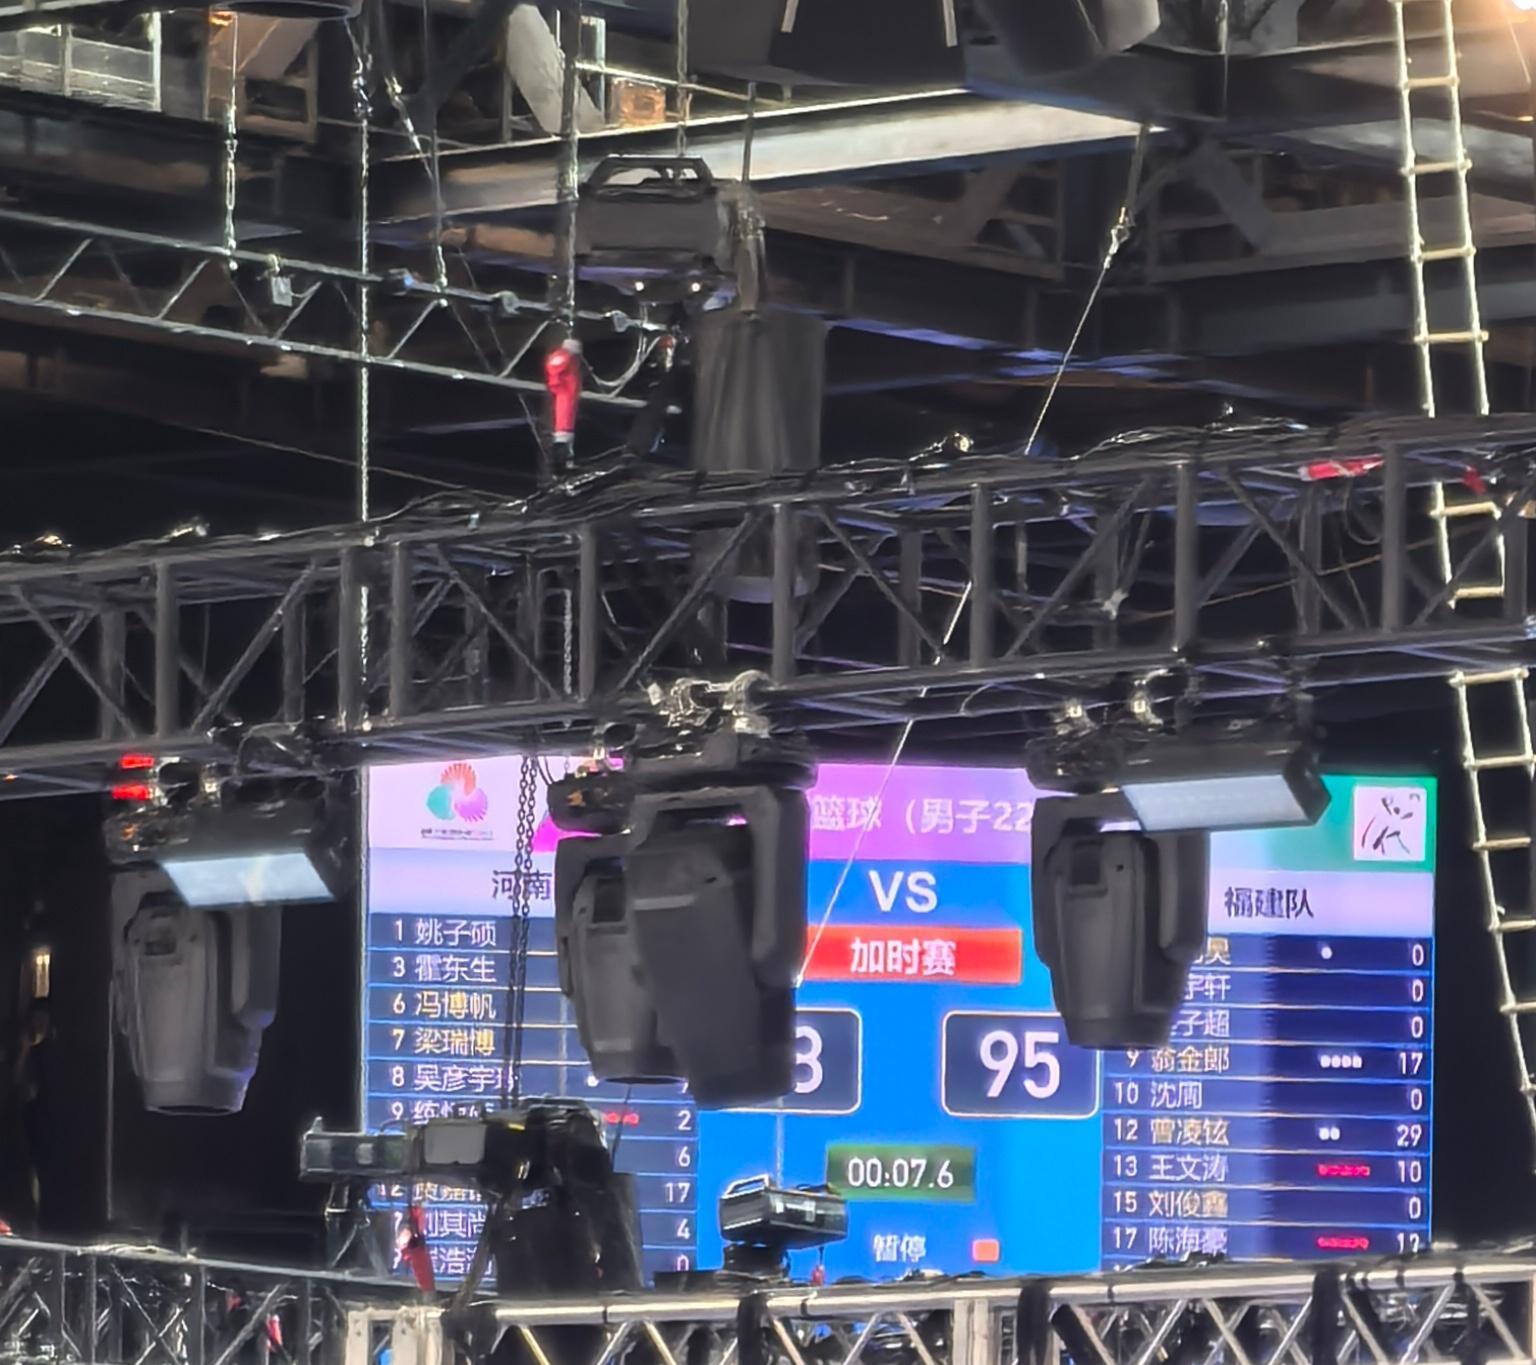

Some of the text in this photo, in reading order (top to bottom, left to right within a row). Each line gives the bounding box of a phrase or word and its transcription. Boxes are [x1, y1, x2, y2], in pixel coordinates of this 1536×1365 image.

[869, 870, 936, 912] VS
[395, 919, 402, 940] 1
[393, 956, 405, 977] 3
[393, 993, 405, 1014] 6
[393, 1029, 405, 1050] 7
[980, 1030, 1059, 1098] 95
[1400, 1052, 1422, 1074] 17
[392, 1065, 404, 1086] 8
[1115, 1082, 1138, 1104] 10
[678, 1110, 690, 1130] 2
[1115, 1118, 1421, 1146] 12 29
[679, 1146, 690, 1166] 6
[848, 1157, 953, 1188] 00:07.6
[1114, 1155, 1137, 1176] 13
[1398, 1161, 1421, 1182] 10
[665, 1182, 690, 1202] 17
[1114, 1191, 1137, 1212] 15
[1114, 1227, 1137, 1248] 17
